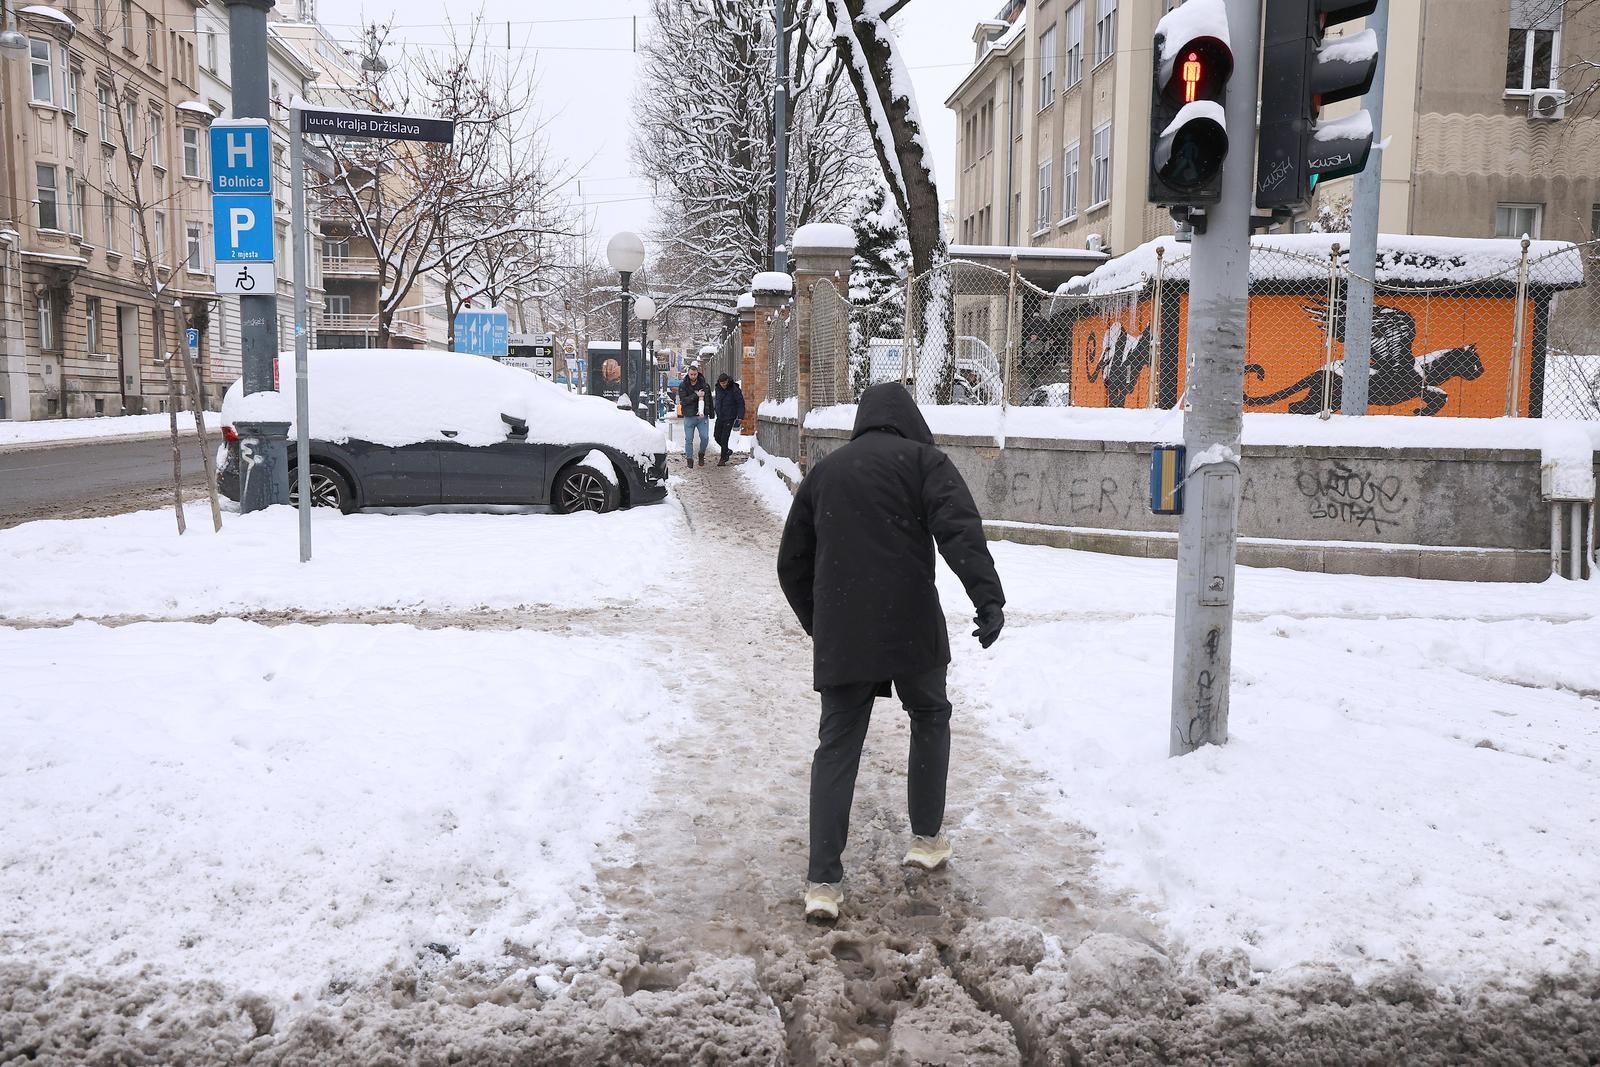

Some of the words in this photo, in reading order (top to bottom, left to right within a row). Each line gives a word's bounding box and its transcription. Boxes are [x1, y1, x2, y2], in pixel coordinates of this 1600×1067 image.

[309, 118, 334, 126] ULICA
[336, 117, 367, 132] kralja
[369, 120, 420, 135] Držislava
[227, 132, 254, 168] H
[219, 175, 264, 188] Bolnica
[230, 207, 255, 248] P
[231, 250, 236, 258] 2
[237, 250, 259, 259] mjesta
